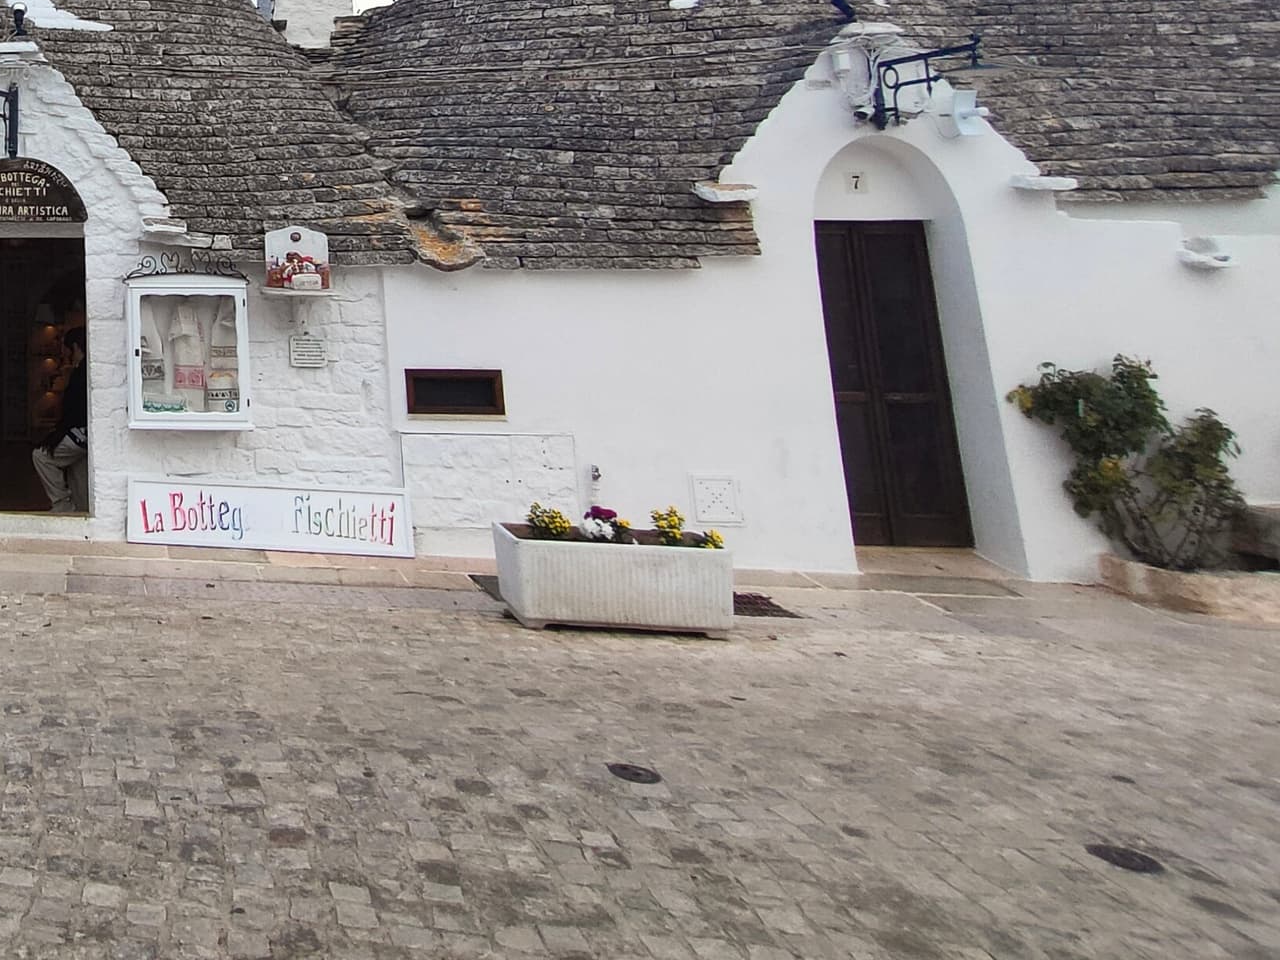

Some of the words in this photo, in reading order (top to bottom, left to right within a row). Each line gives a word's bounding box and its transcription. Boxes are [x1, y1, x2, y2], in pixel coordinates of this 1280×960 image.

[851, 175, 860, 190] 7
[17, 205, 68, 216] ARTISTICA
[140, 498, 165, 534] La
[168, 490, 249, 541] Botteg
[292, 493, 396, 546] Fischietti
